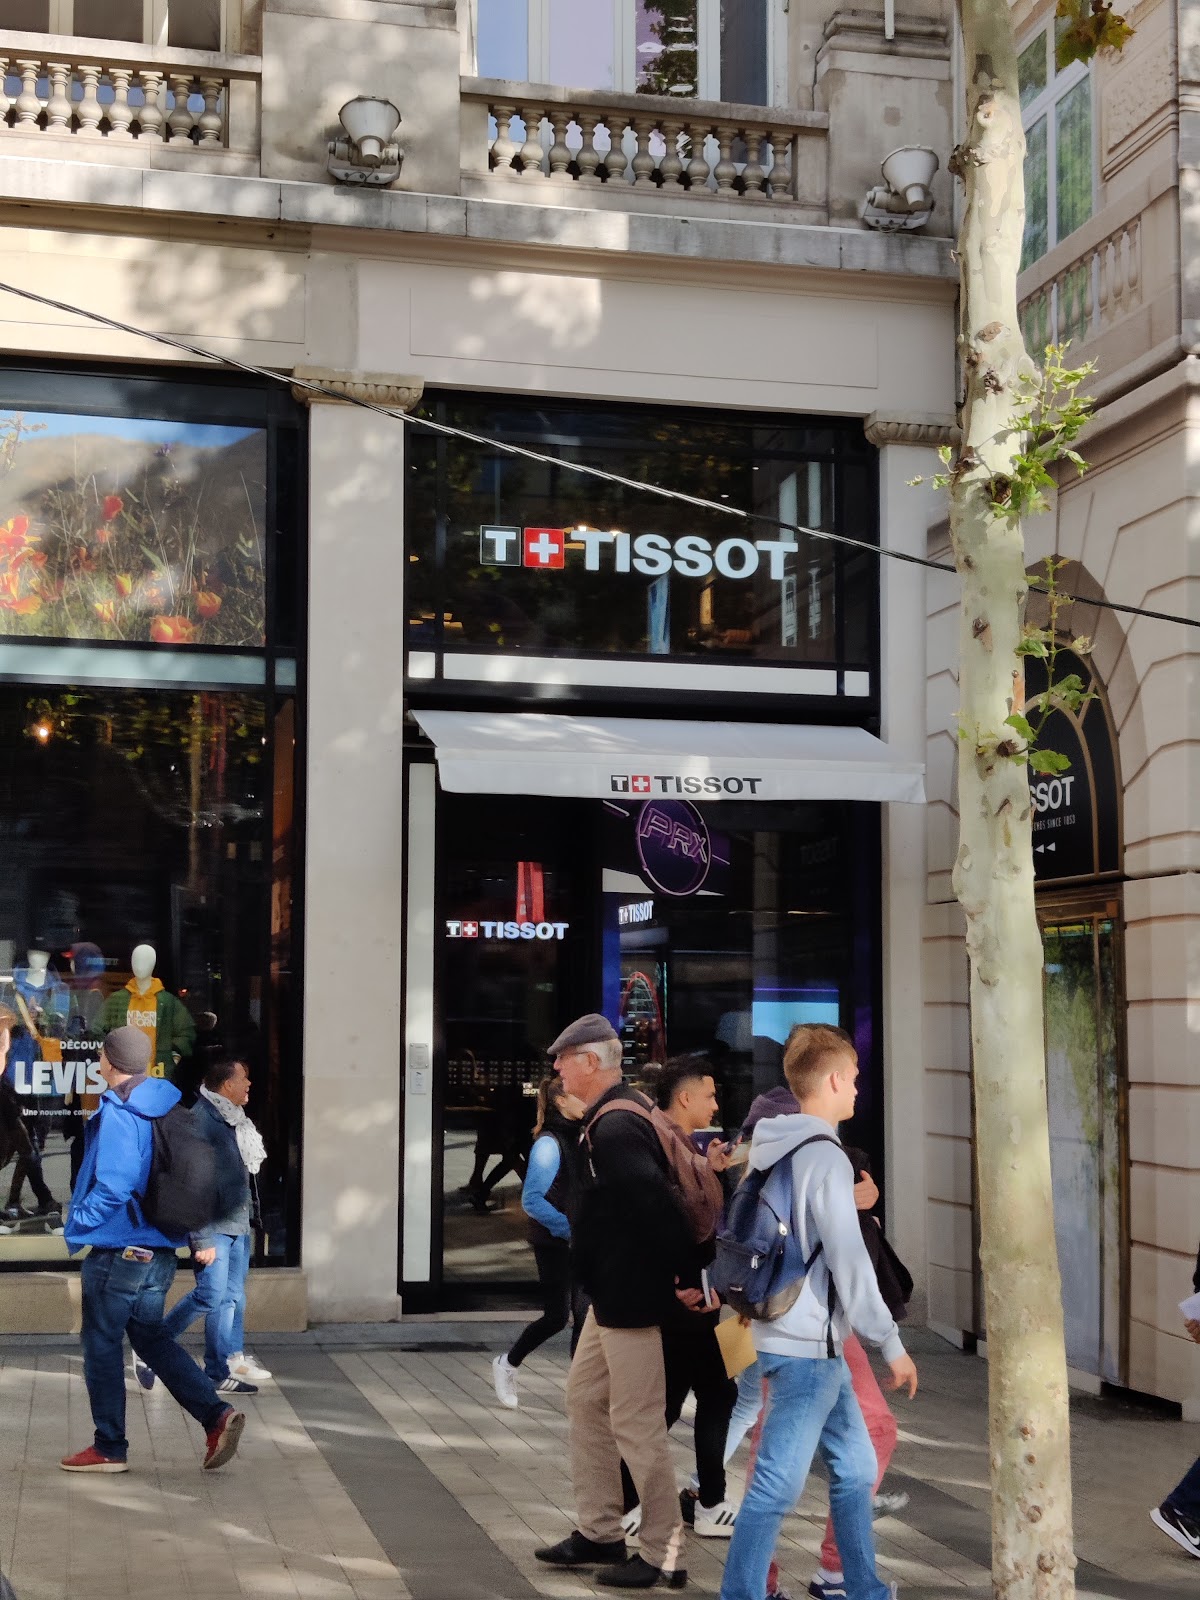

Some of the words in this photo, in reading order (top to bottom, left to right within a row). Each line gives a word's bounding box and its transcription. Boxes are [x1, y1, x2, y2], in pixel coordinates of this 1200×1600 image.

[570, 531, 799, 580] TISSOT
[654, 775, 763, 794] TISSOT
[639, 807, 708, 864] PRX
[628, 900, 654, 923] TISSOT
[480, 921, 570, 940] TISSOT
[60, 1040, 104, 1050] DÉCOUV
[15, 1058, 108, 1094] LEVI'S
[22, 1108, 38, 1117] Une
[39, 1108, 72, 1117] nouvelle
